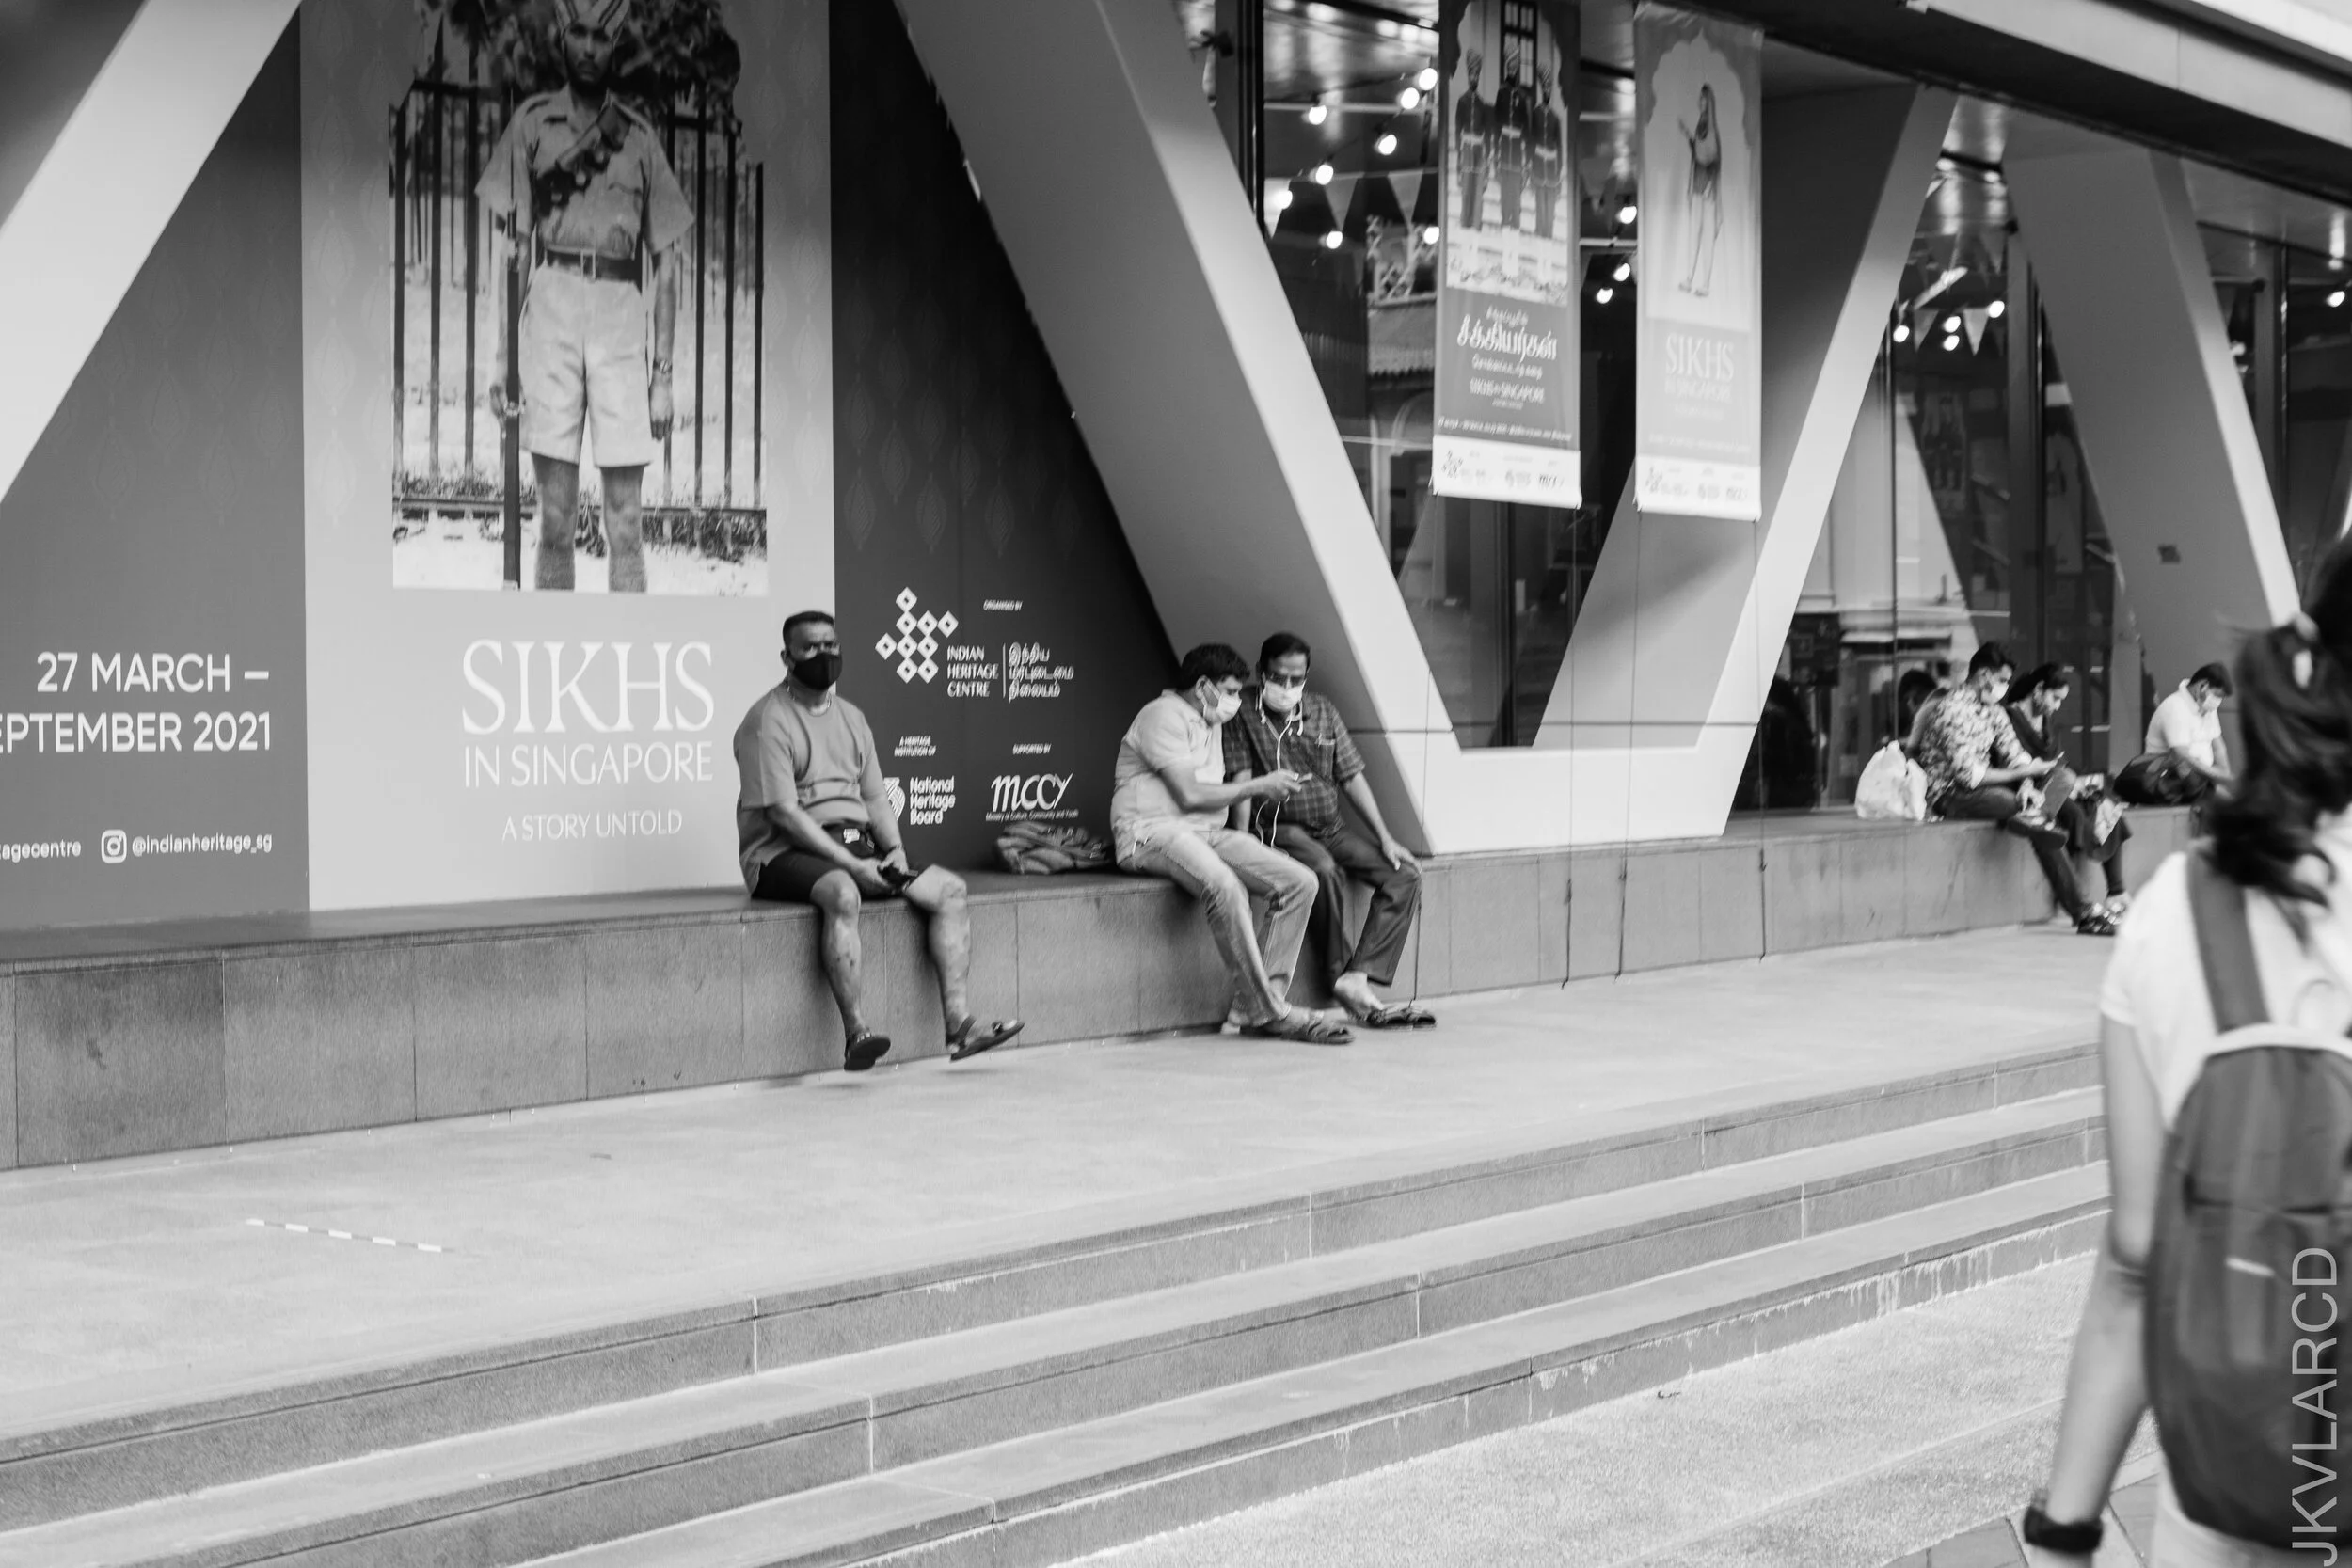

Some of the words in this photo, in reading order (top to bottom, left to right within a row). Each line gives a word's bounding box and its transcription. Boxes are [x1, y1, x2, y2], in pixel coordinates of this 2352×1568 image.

[1665, 330, 1735, 384] SIKHS
[946, 644, 985, 661] INDIAN
[37, 651, 78, 692] 27
[91, 652, 230, 692] MARCH
[946, 662, 999, 679] HERITAGE
[461, 638, 715, 735] SIKHS
[946, 680, 991, 697] CENTRE
[0, 712, 182, 753] PTEMBER
[193, 711, 270, 752] 2021
[464, 744, 501, 788] IN
[510, 740, 714, 786] SINGAPORE
[910, 775, 955, 795] National
[910, 792, 956, 812] Heritage
[910, 808, 944, 825] Board
[501, 816, 518, 845] A
[521, 812, 591, 842] STORY
[596, 808, 683, 838] UNTOLD
[0, 838, 82, 863] agecentre
[132, 832, 273, 858] @indianheritage_sg
